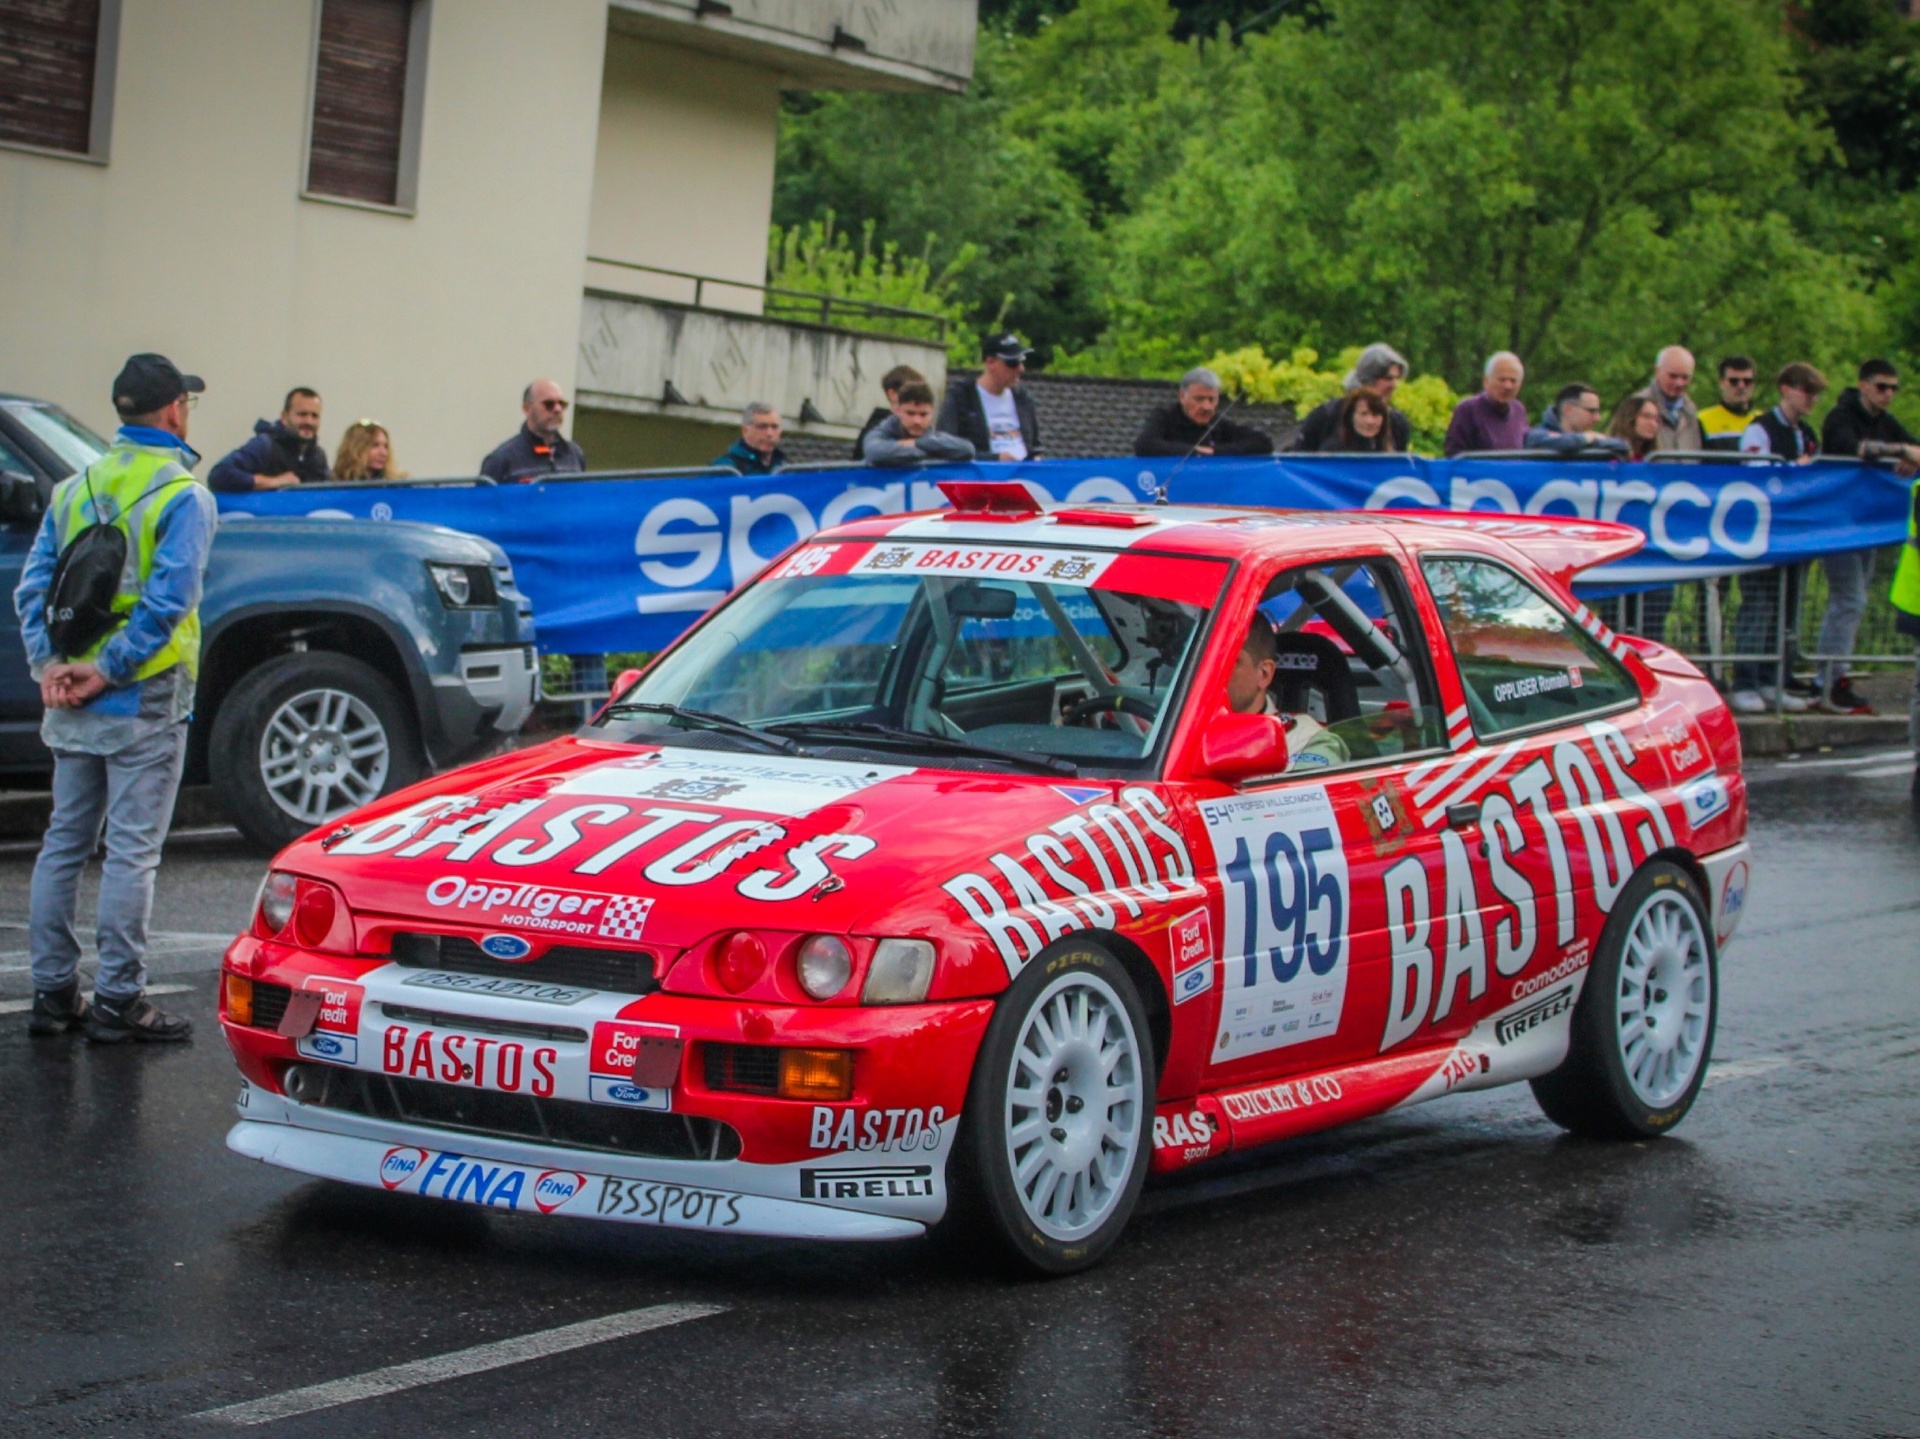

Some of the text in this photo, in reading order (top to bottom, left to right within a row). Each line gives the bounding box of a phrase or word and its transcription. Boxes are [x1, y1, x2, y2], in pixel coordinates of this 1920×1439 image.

[774, 545, 842, 579] 195
[915, 549, 1045, 574] BASTOS
[1494, 671, 1570, 702] OPPLIGER Romain
[326, 795, 877, 901] BASTOS
[426, 876, 603, 917] Oppliger
[941, 787, 1196, 981] BASTOS
[1379, 720, 1676, 1053] BASTOS
[501, 914, 595, 934] MOTORSPORT
[1225, 827, 1343, 988] 195
[491, 938, 517, 953] Ford
[1181, 938, 1204, 961] Credit
[1182, 922, 1200, 944] Ford
[1512, 950, 1589, 1000] Cromodora
[320, 1008, 347, 1024] redit
[1495, 984, 1573, 1047] PIRELLI
[316, 1040, 338, 1053] Ford
[605, 1048, 638, 1067] Cre
[613, 1031, 640, 1050] For
[383, 1024, 557, 1097] BASTOS
[1442, 1050, 1476, 1090] TAG
[615, 1086, 641, 1100] Ford
[1223, 1076, 1342, 1120] CRICKET & CO
[809, 1105, 944, 1152] BASTOS
[1152, 1111, 1211, 1149] RAS
[384, 1154, 416, 1173] FINA
[1184, 1144, 1210, 1162] sport
[419, 1151, 525, 1210] FINA
[538, 1178, 574, 1197] FINA
[800, 1164, 933, 1199] PIRELLI
[598, 1175, 743, 1226] BSSPOTS
